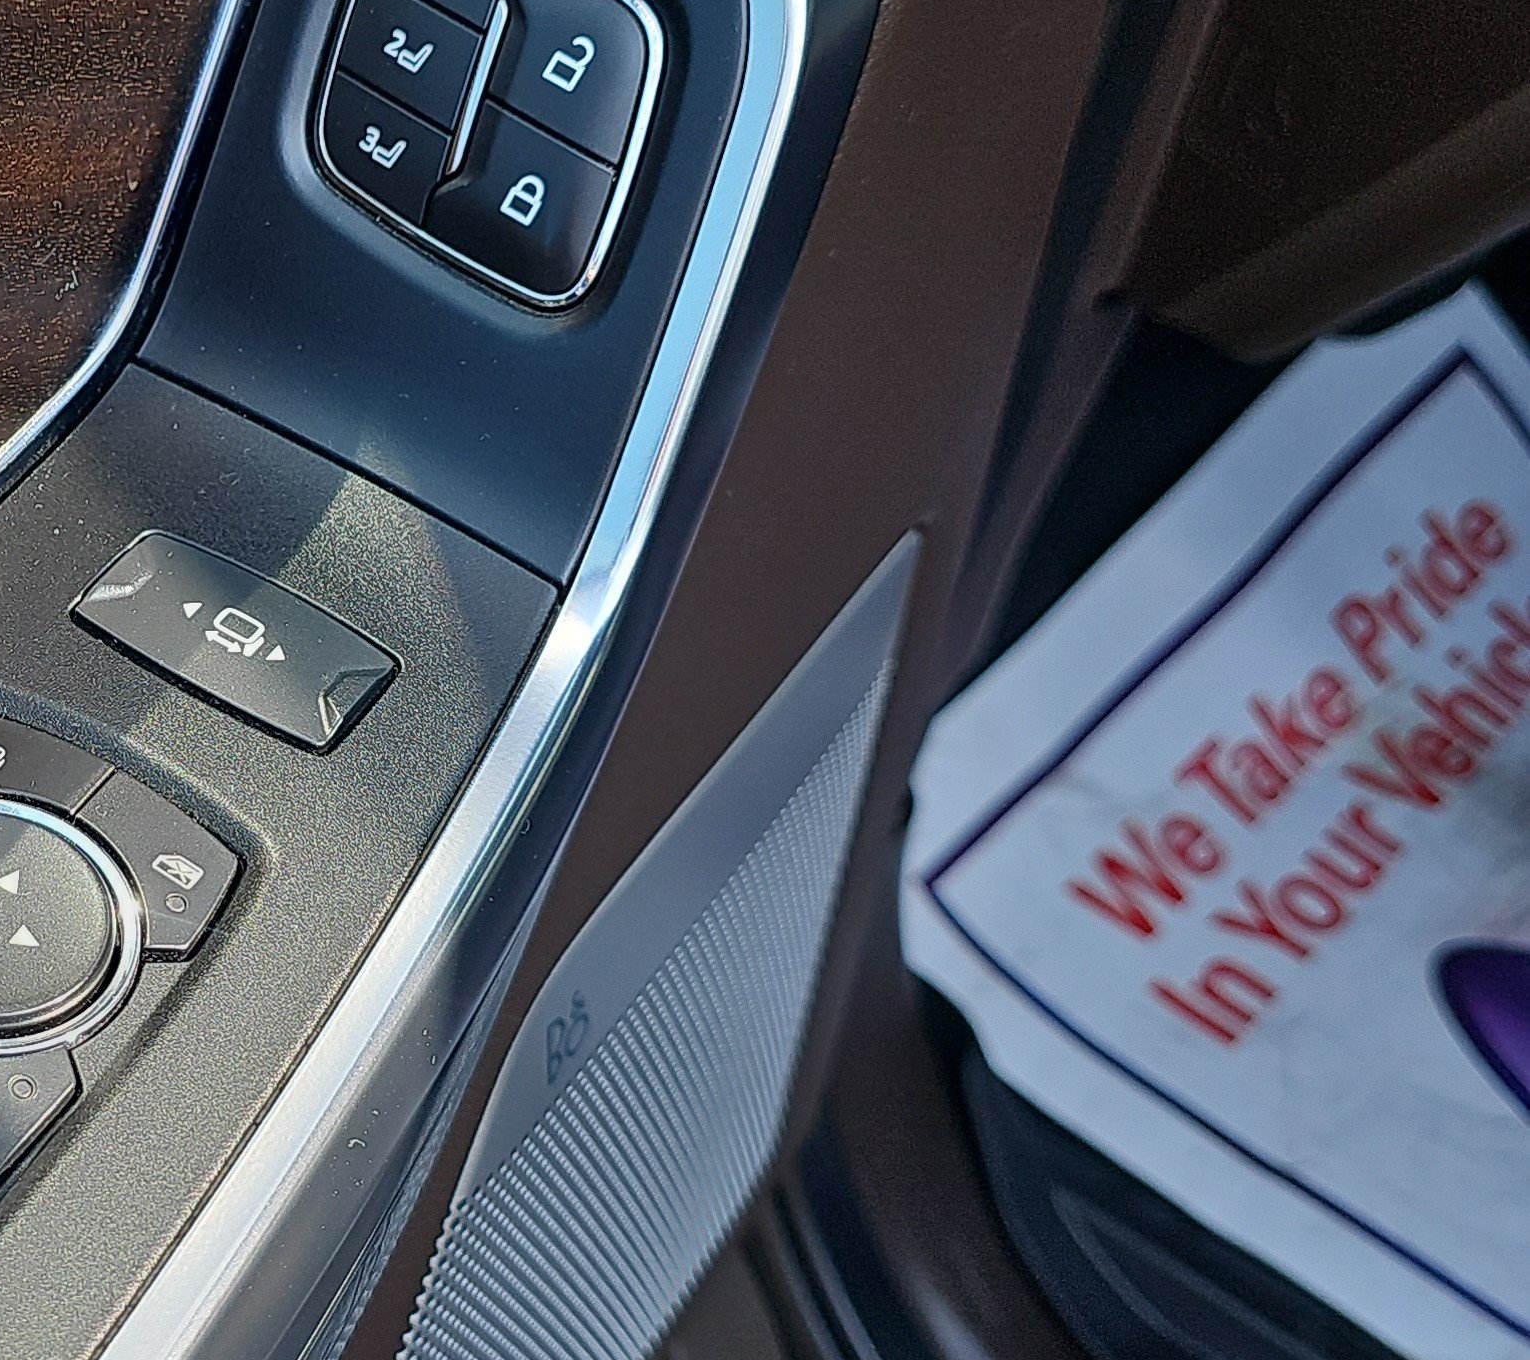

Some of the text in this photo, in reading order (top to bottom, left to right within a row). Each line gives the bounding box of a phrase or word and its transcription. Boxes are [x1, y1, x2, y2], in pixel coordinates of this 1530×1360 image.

[358, 125, 381, 153] 3
[383, 28, 407, 58] 2
[1067, 498, 1514, 938] We Take Pride
[1145, 592, 1530, 1046] In Your Vehicl
